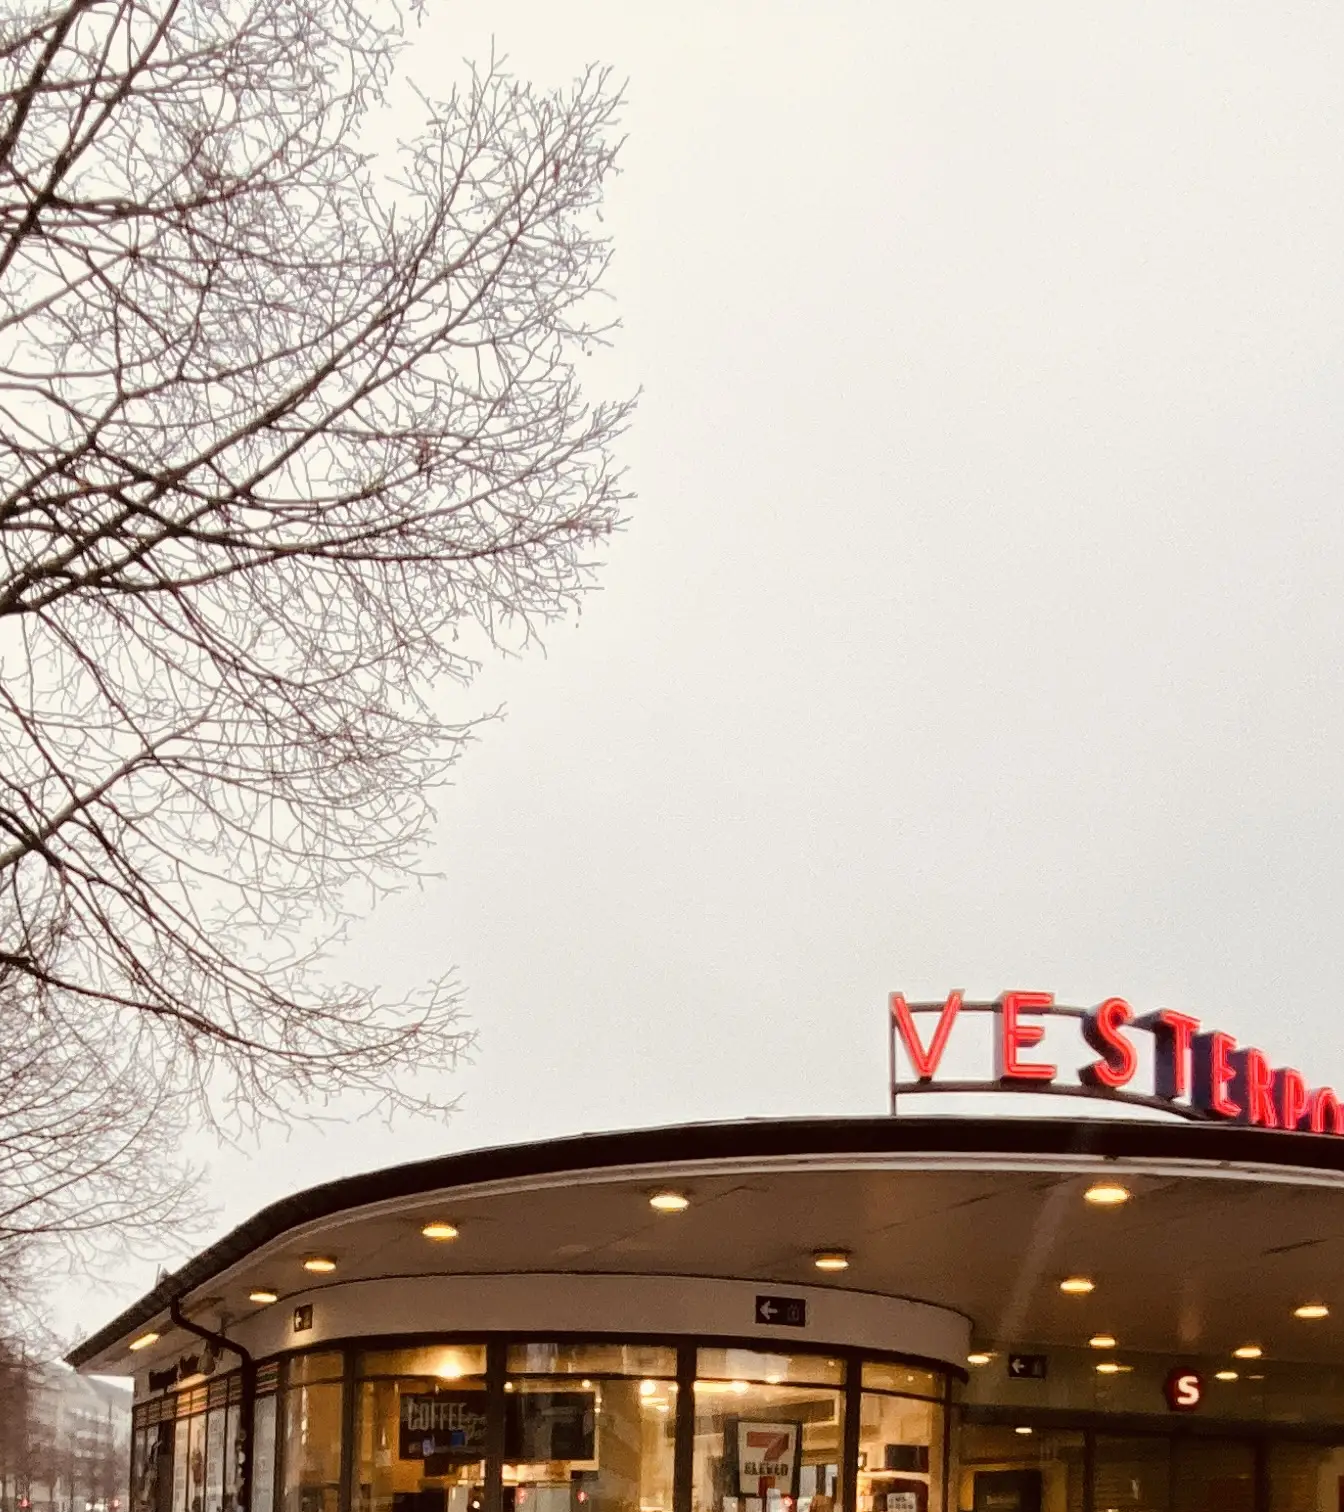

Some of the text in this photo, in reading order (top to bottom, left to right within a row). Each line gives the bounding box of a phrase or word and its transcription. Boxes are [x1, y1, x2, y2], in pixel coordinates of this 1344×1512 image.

[1177, 1375, 1200, 1405] S
[407, 1398, 468, 1432] COFFEE
[746, 1431, 790, 1497] 7
